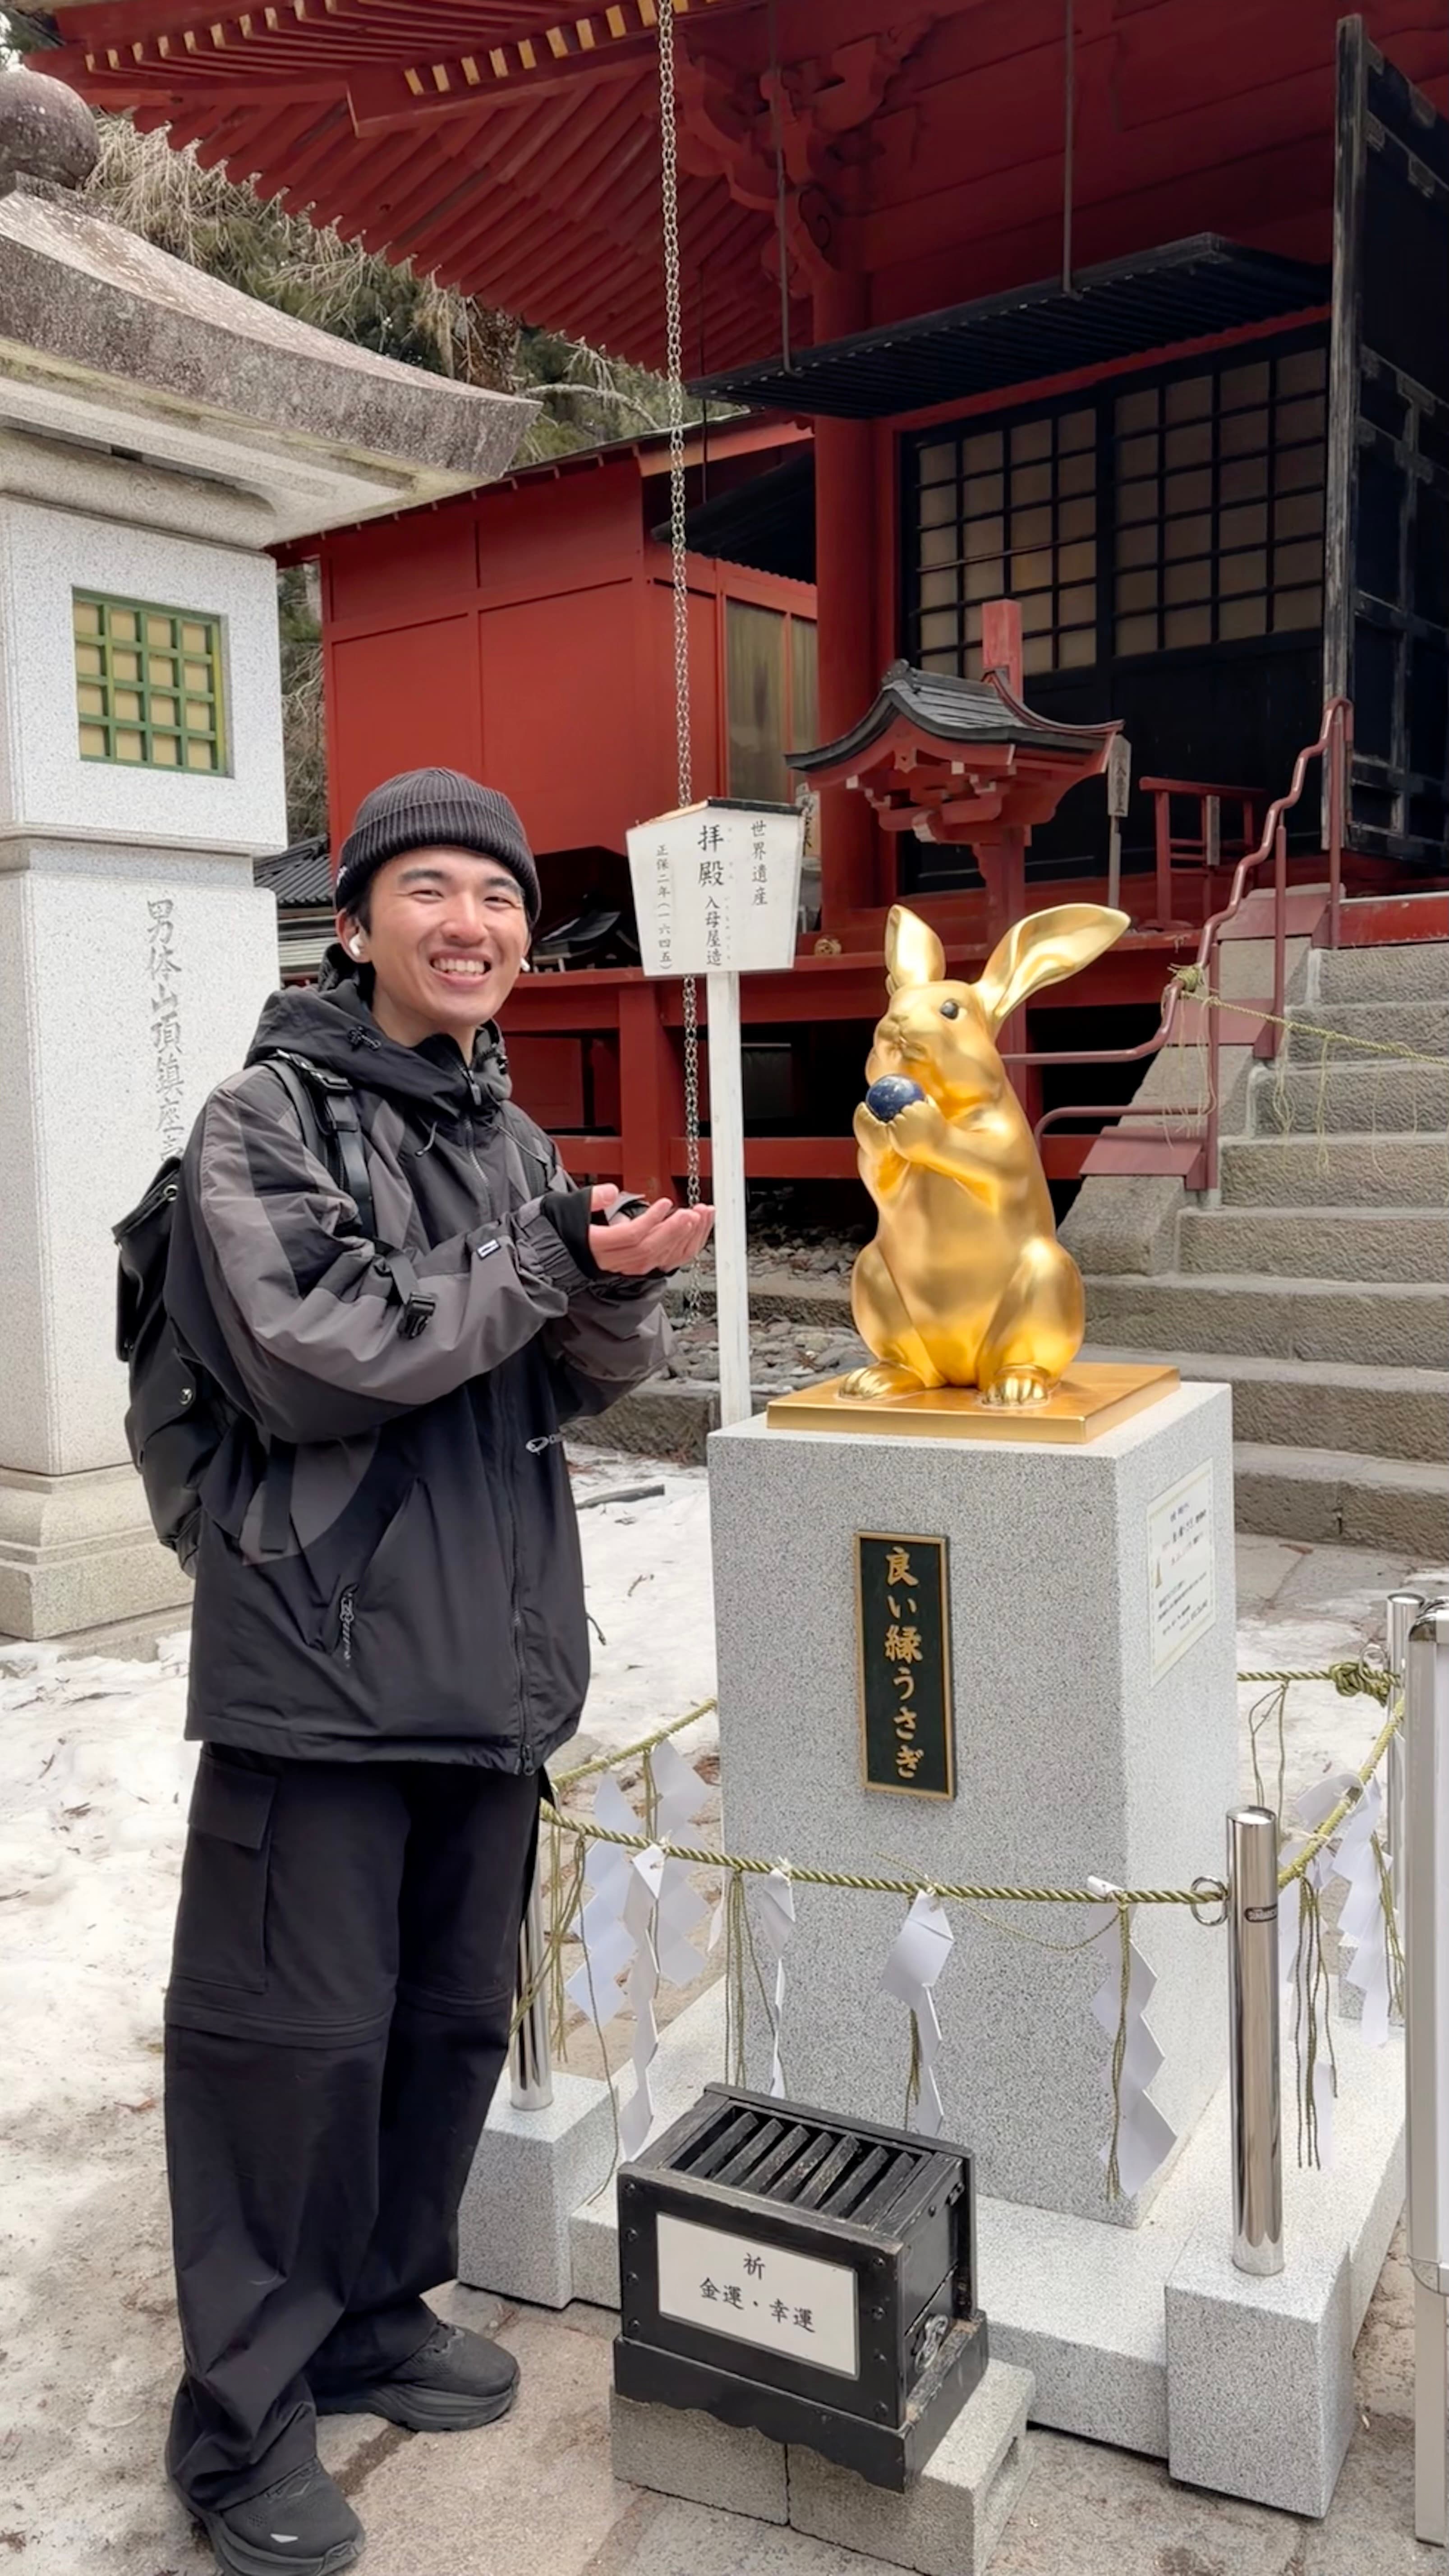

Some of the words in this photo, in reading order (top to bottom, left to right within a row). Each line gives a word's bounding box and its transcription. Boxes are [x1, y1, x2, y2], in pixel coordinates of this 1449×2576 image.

[697, 824, 725, 888] 拝殿
[751, 820, 768, 906] 世界遺産
[705, 895, 722, 966] 入母屋造
[884, 1546, 924, 1779] 良い縁うさぎ
[743, 2253, 766, 2280] 祈
[699, 2277, 816, 2334] 金運・幸運
